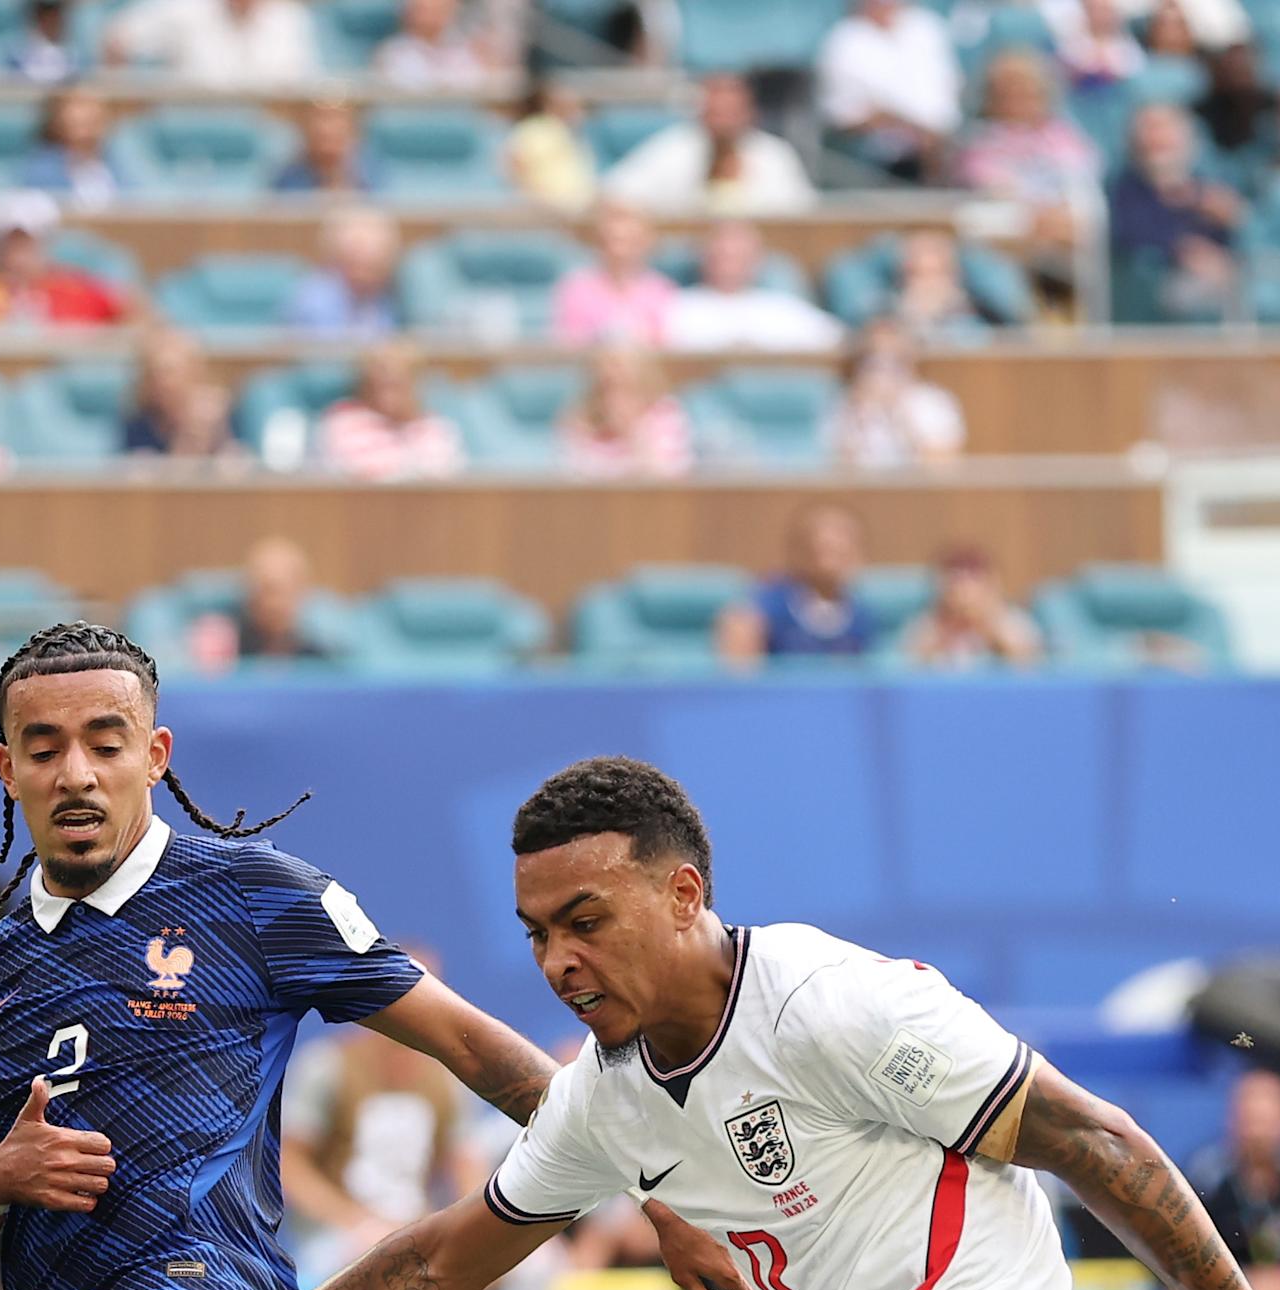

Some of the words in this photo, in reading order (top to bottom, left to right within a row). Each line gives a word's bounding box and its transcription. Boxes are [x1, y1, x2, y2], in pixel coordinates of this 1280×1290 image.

[127, 999, 152, 1009] FRANCE
[46, 1023, 89, 1100] 2
[881, 1042, 911, 1078] FOOTBALL
[890, 1046, 924, 1086] UNITES
[903, 1080, 919, 1094] the
[913, 1051, 936, 1082] World
[922, 1073, 937, 1089] FIFA
[772, 1181, 811, 1208] FRANCE
